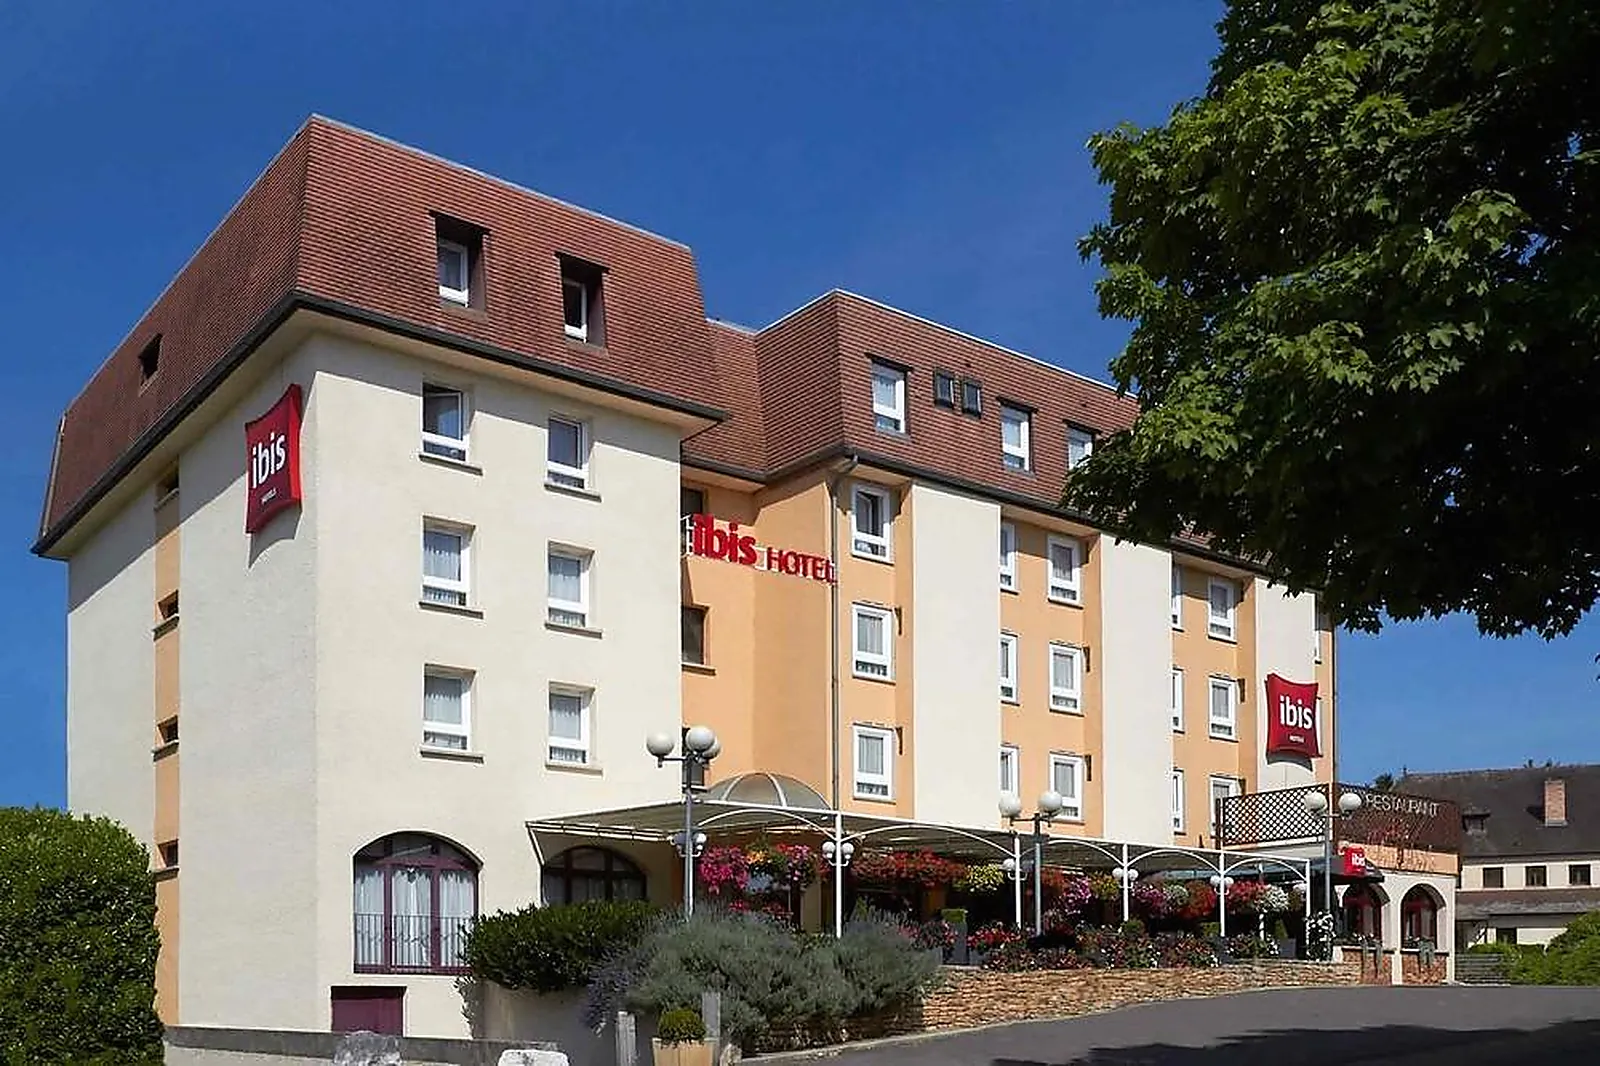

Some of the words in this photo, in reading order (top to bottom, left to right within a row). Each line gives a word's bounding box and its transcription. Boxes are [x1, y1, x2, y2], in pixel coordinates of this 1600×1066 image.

[253, 431, 285, 489] ibis
[692, 513, 757, 565] ibis
[767, 547, 837, 584] HOTEL
[1280, 695, 1312, 729] ibis
